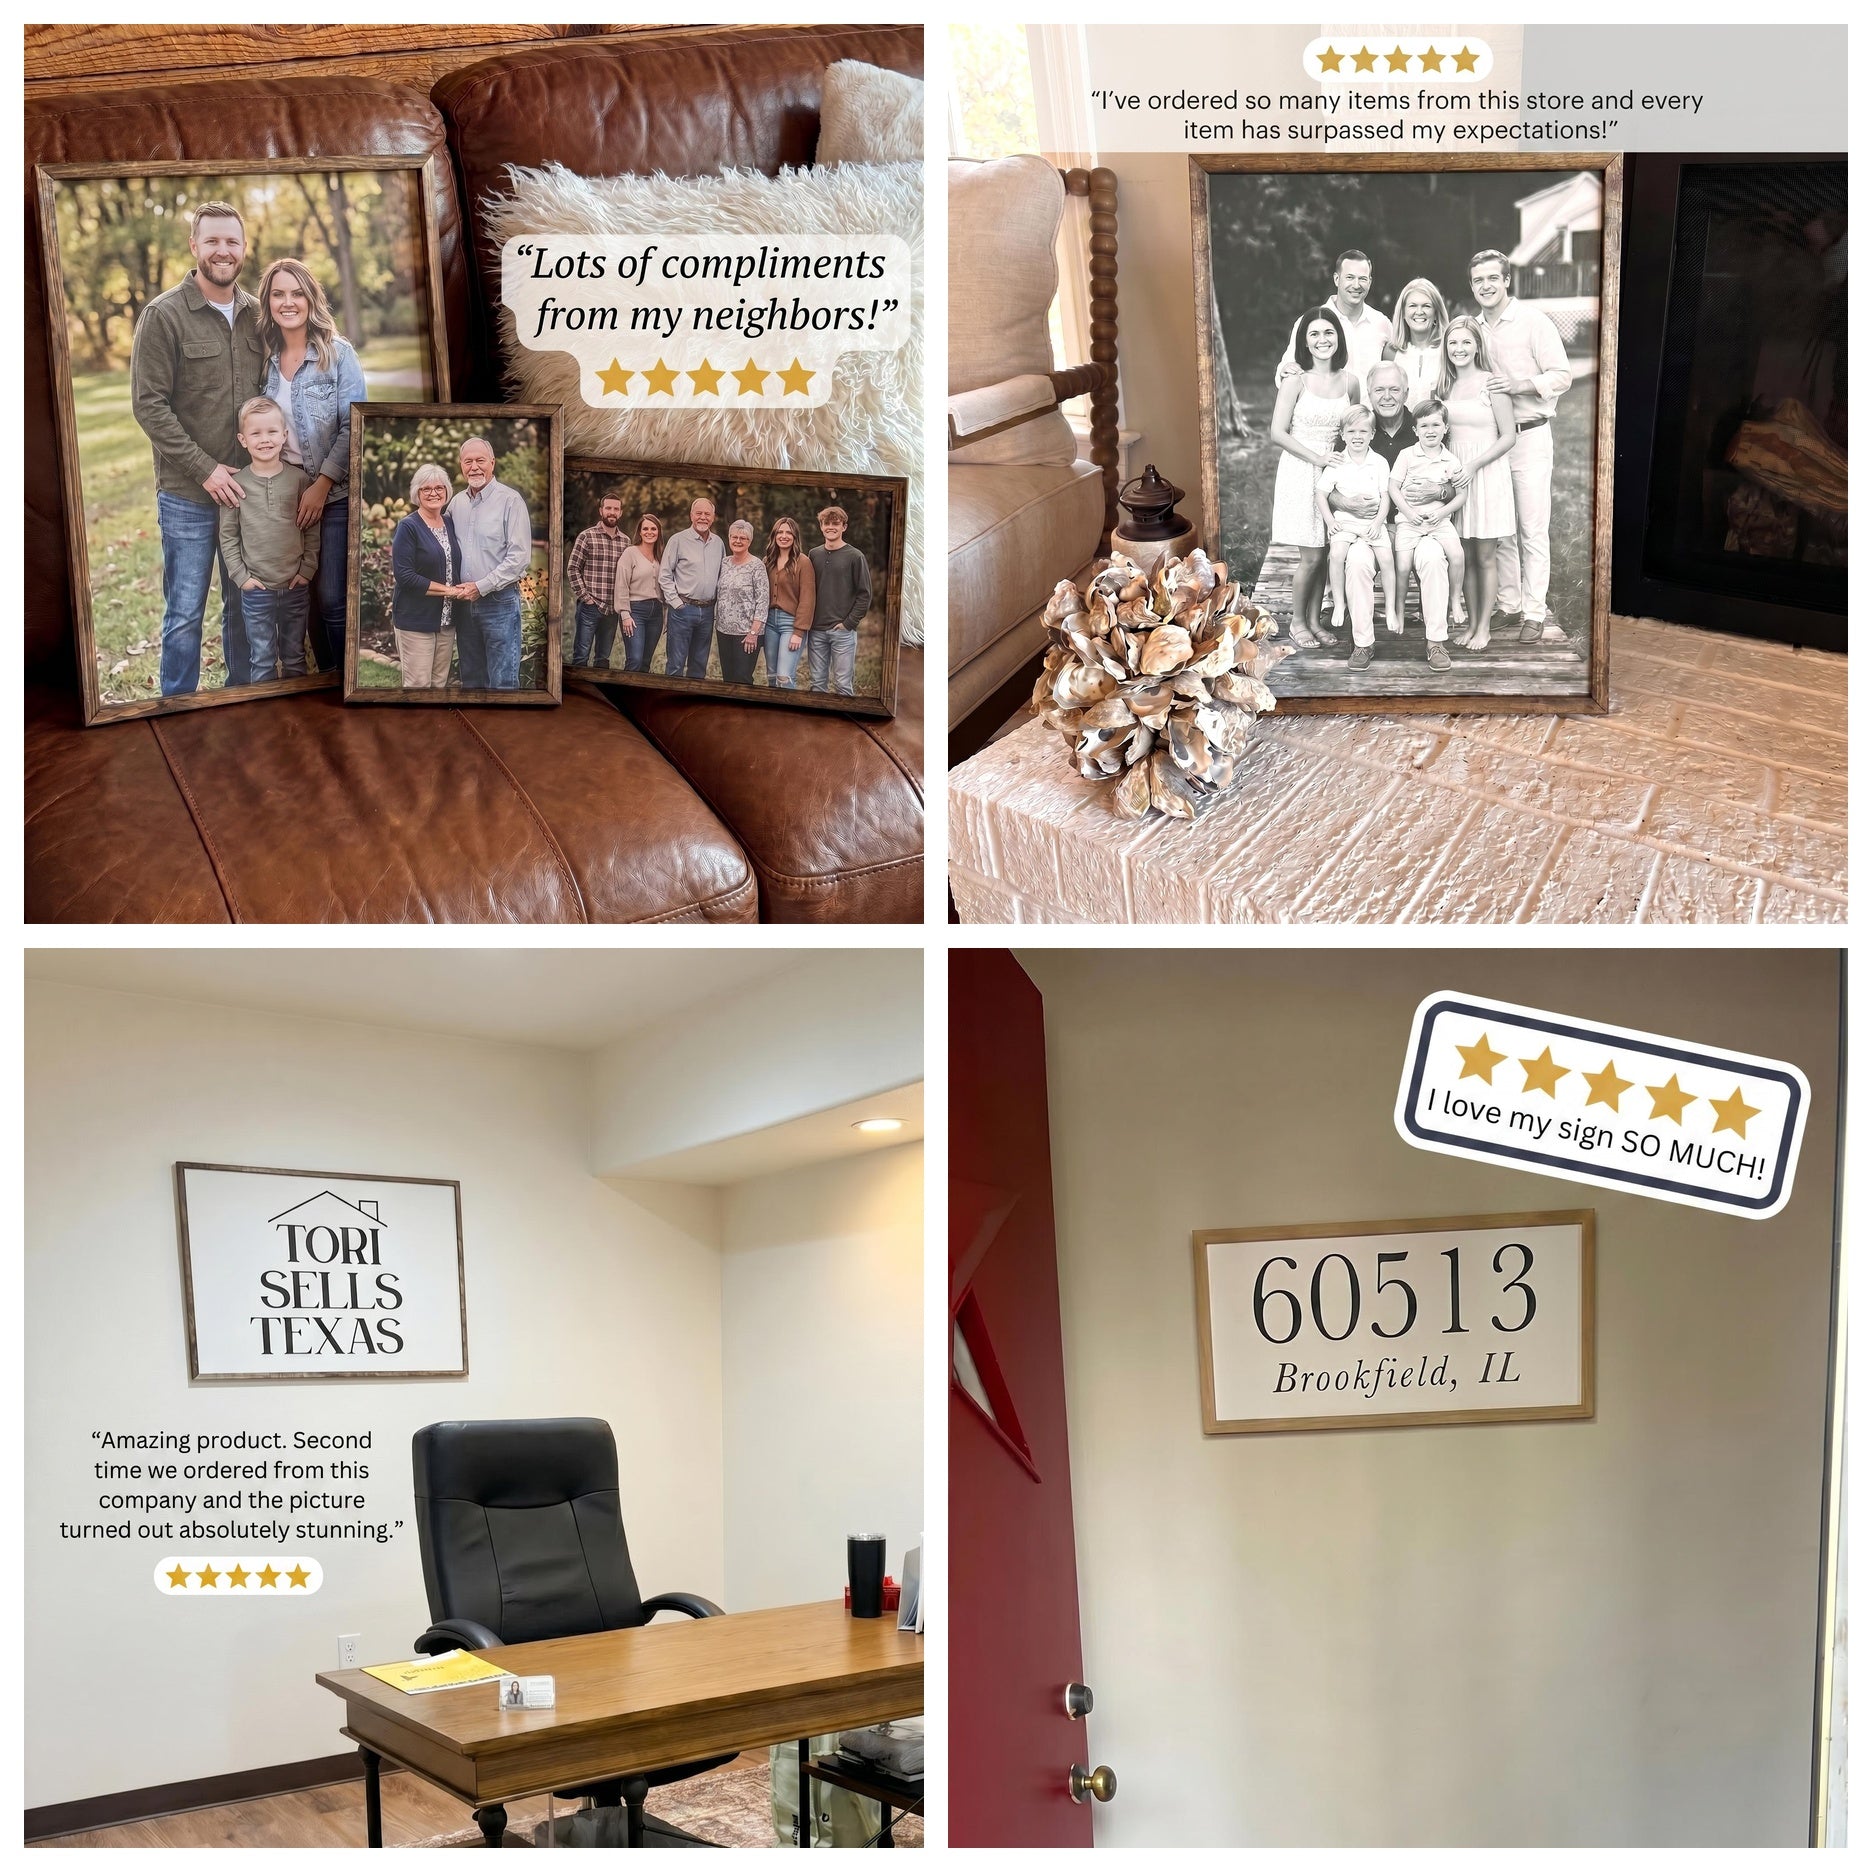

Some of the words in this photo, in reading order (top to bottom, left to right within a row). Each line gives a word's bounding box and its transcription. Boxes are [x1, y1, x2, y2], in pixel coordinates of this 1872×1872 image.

[276, 1224, 382, 1265] TORI
[261, 1271, 402, 1310] SELLS
[1252, 1243, 1537, 1344] 60513
[250, 1317, 403, 1354] TEXAS
[1273, 1355, 1456, 1398] Brookfield,
[1479, 1352, 1520, 1383] IL
